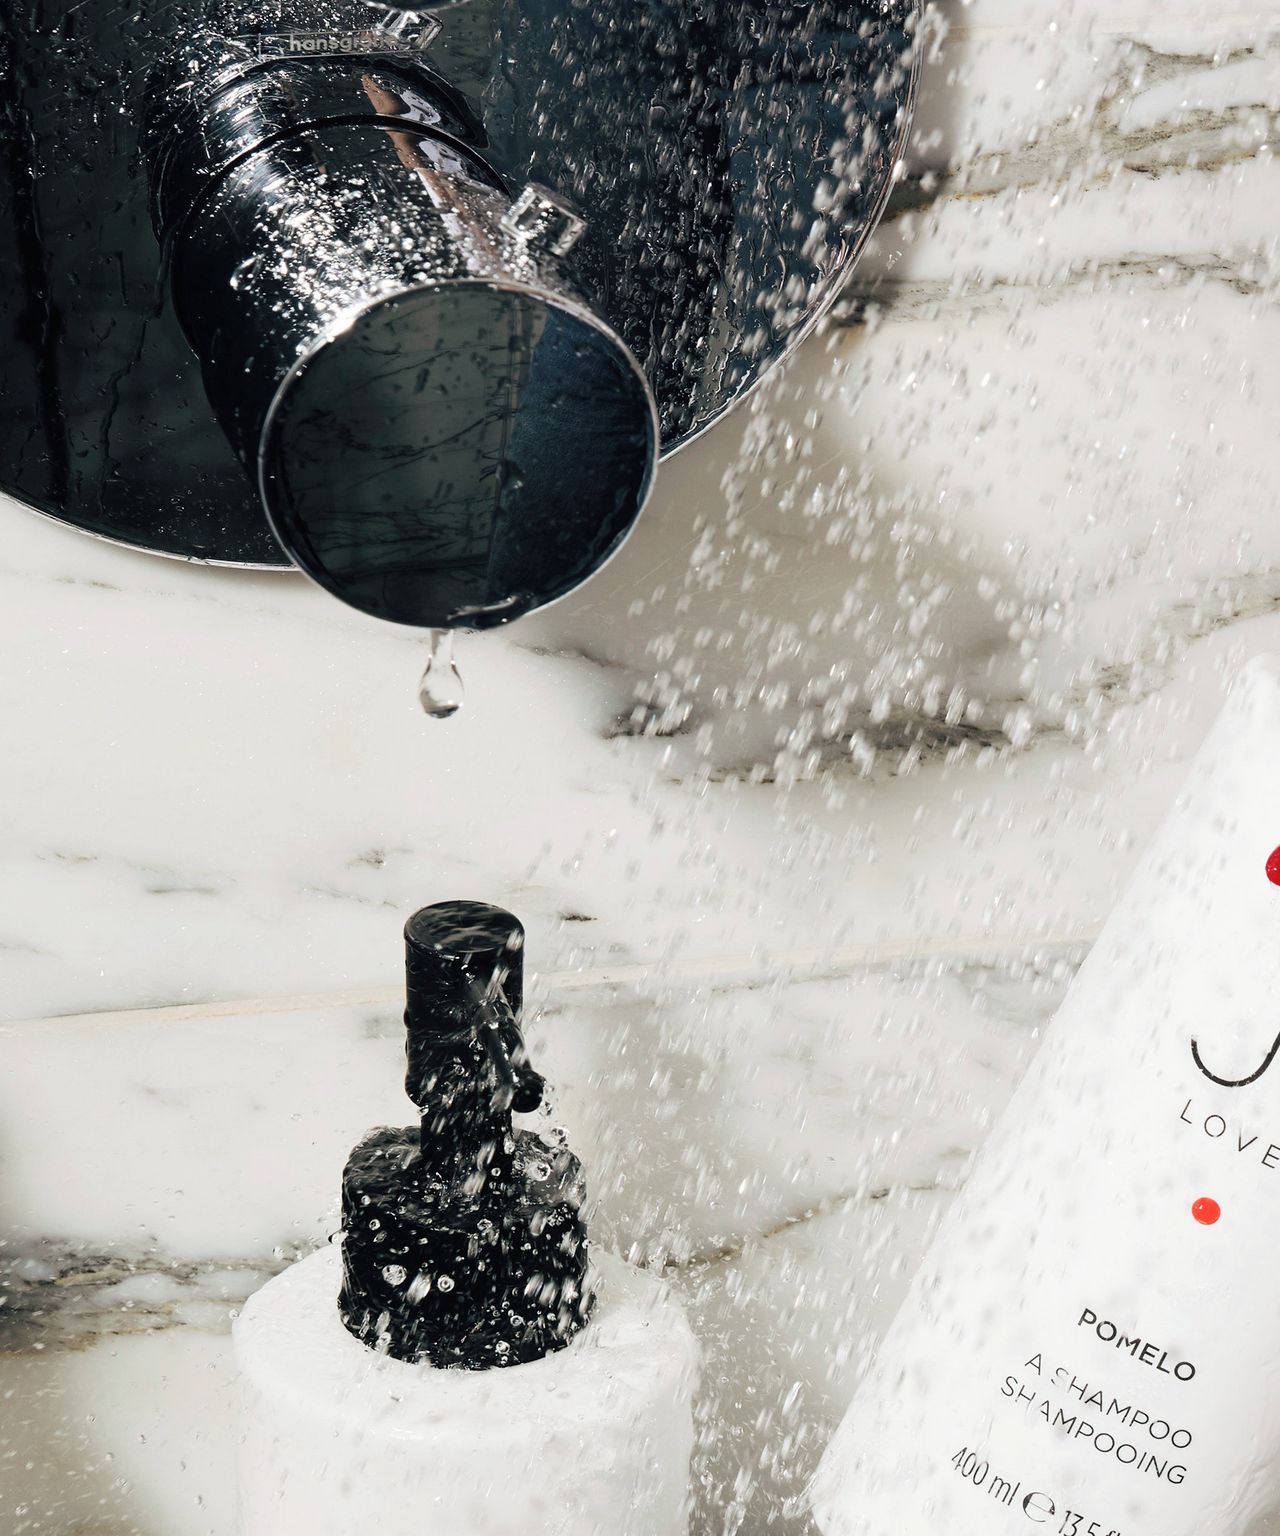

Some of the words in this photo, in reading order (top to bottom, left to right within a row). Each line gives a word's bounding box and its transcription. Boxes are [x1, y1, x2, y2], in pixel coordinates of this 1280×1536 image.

[1077, 1308, 1196, 1381] POMELO
[1000, 1376, 1187, 1484] SHAMPOOING
[1024, 1353, 1042, 1375] A
[1050, 1367, 1192, 1448] SHAMPOO
[951, 1447, 989, 1485] 400
[988, 1475, 1020, 1505] ml
